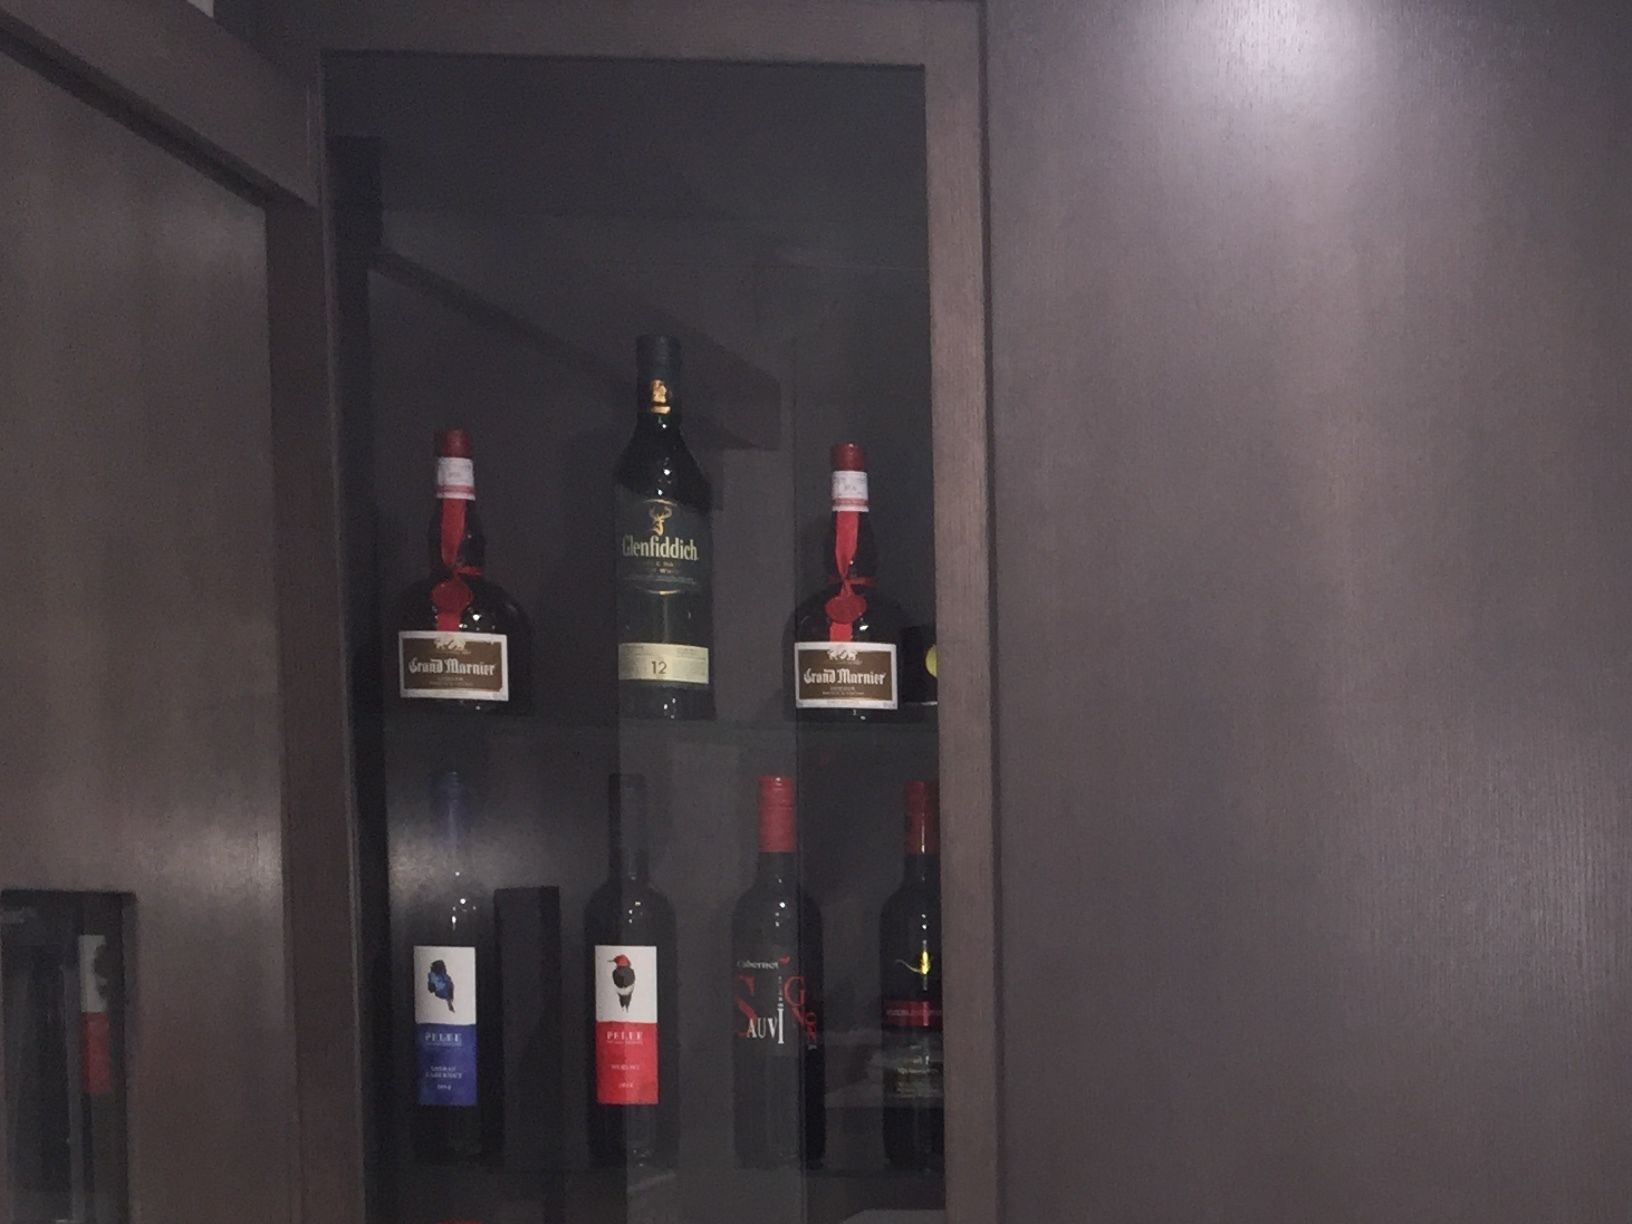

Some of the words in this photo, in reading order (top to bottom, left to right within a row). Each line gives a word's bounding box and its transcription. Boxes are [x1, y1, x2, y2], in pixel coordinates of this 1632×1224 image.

[622, 534, 699, 561] Glenfiddich
[408, 657, 443, 674] Grand
[444, 657, 496, 676] Marnier
[651, 660, 668, 675] 12
[803, 667, 836, 684] Grand
[836, 667, 887, 685] Marnier
